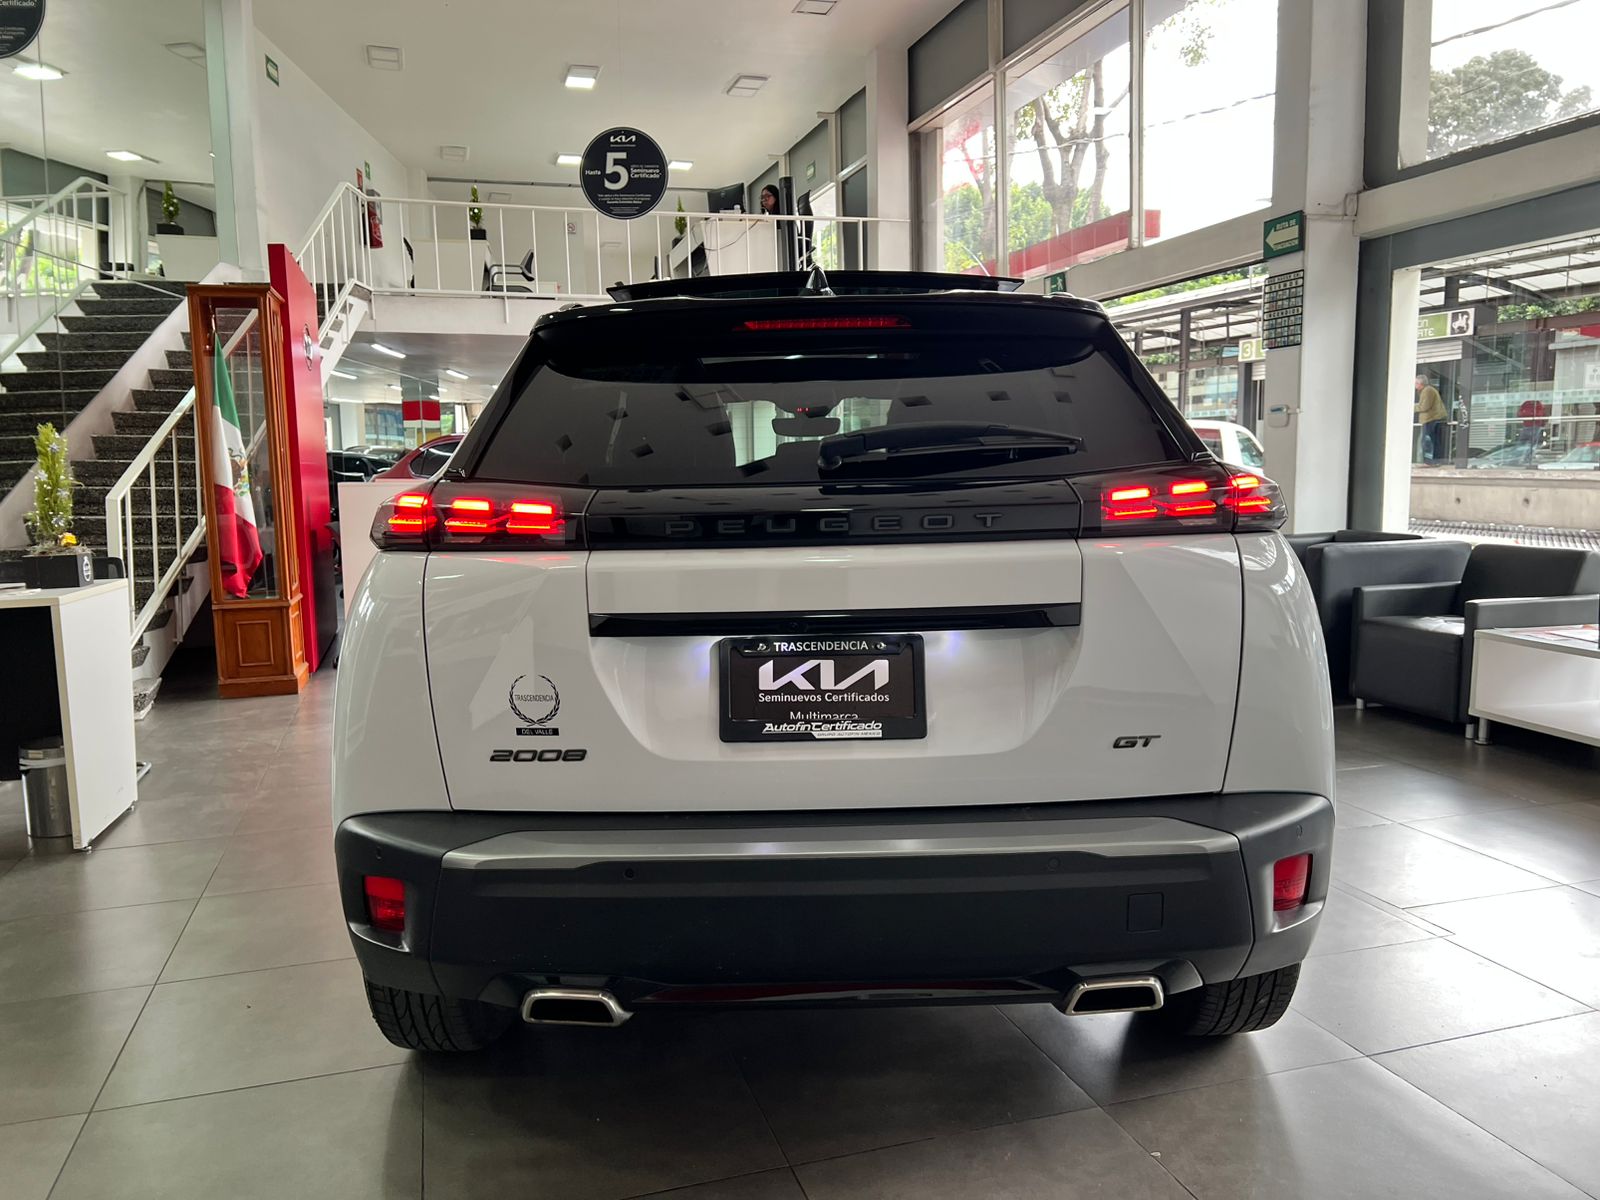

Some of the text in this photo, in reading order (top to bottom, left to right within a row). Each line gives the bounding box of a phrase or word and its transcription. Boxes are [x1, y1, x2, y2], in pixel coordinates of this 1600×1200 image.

[610, 135, 636, 143] KIA
[604, 152, 629, 190] 5
[1289, 218, 1297, 226] DE
[1266, 306, 1300, 319] INCENDIOS
[1243, 343, 1251, 357] 3
[664, 512, 1003, 536] PEUGEOT
[773, 641, 869, 652] TRASCENDENCIA
[758, 659, 890, 691] KIA
[514, 694, 554, 702] TRASCENDENCIA
[758, 692, 890, 703] Seminuevos Certificados
[790, 711, 859, 720] Multimarca
[1113, 735, 1161, 749] GT
[489, 749, 587, 762] 2008
